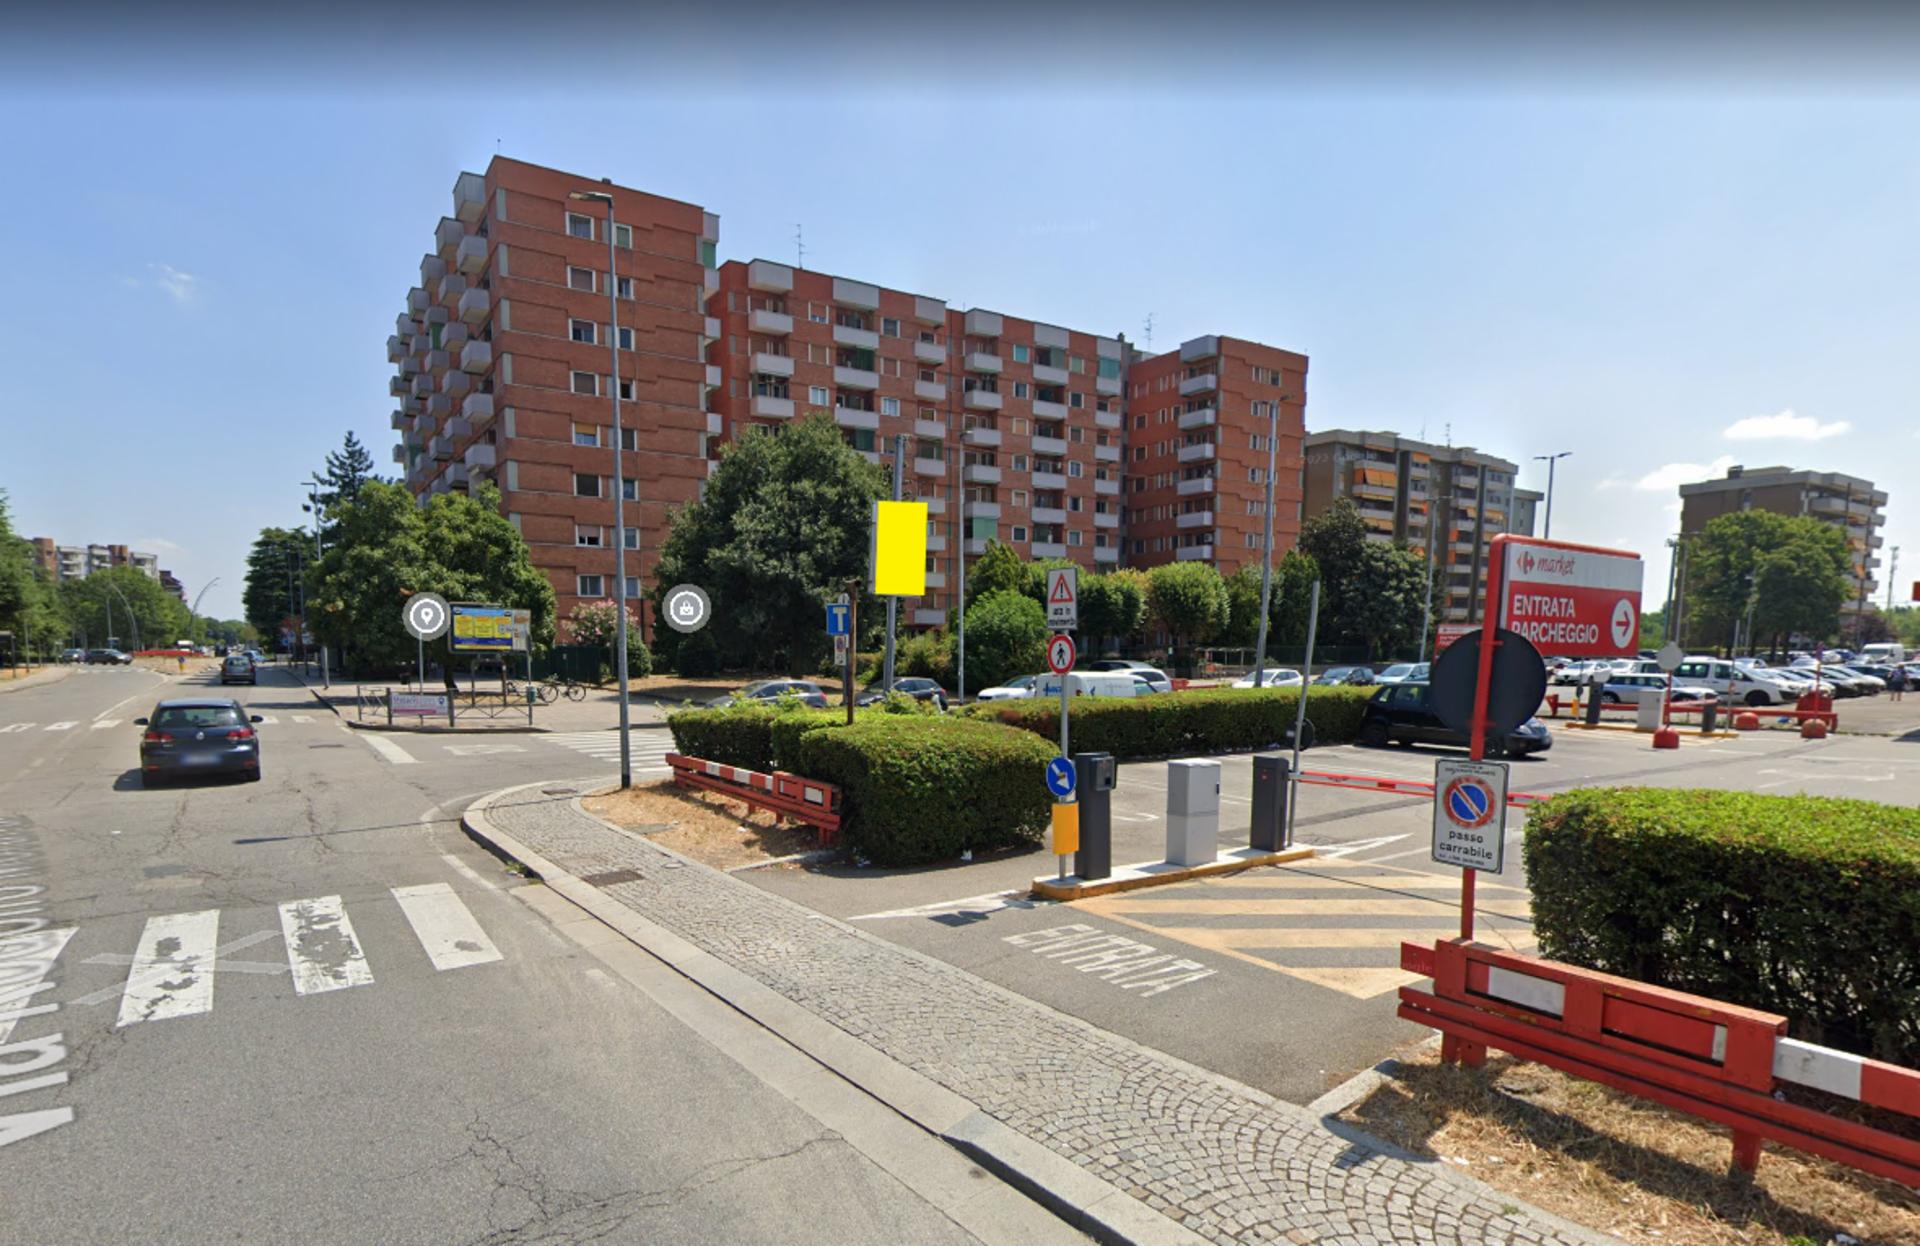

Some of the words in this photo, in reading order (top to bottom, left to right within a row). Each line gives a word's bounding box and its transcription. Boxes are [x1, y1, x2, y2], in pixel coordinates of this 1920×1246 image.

[1536, 555, 1577, 577] market
[1512, 593, 1577, 618] ENTRATA
[1511, 620, 1599, 645] PARCHEGGIO
[1448, 830, 1484, 844] passo
[1439, 842, 1493, 859] carrabile
[1000, 923, 1219, 998] ENTRATA
